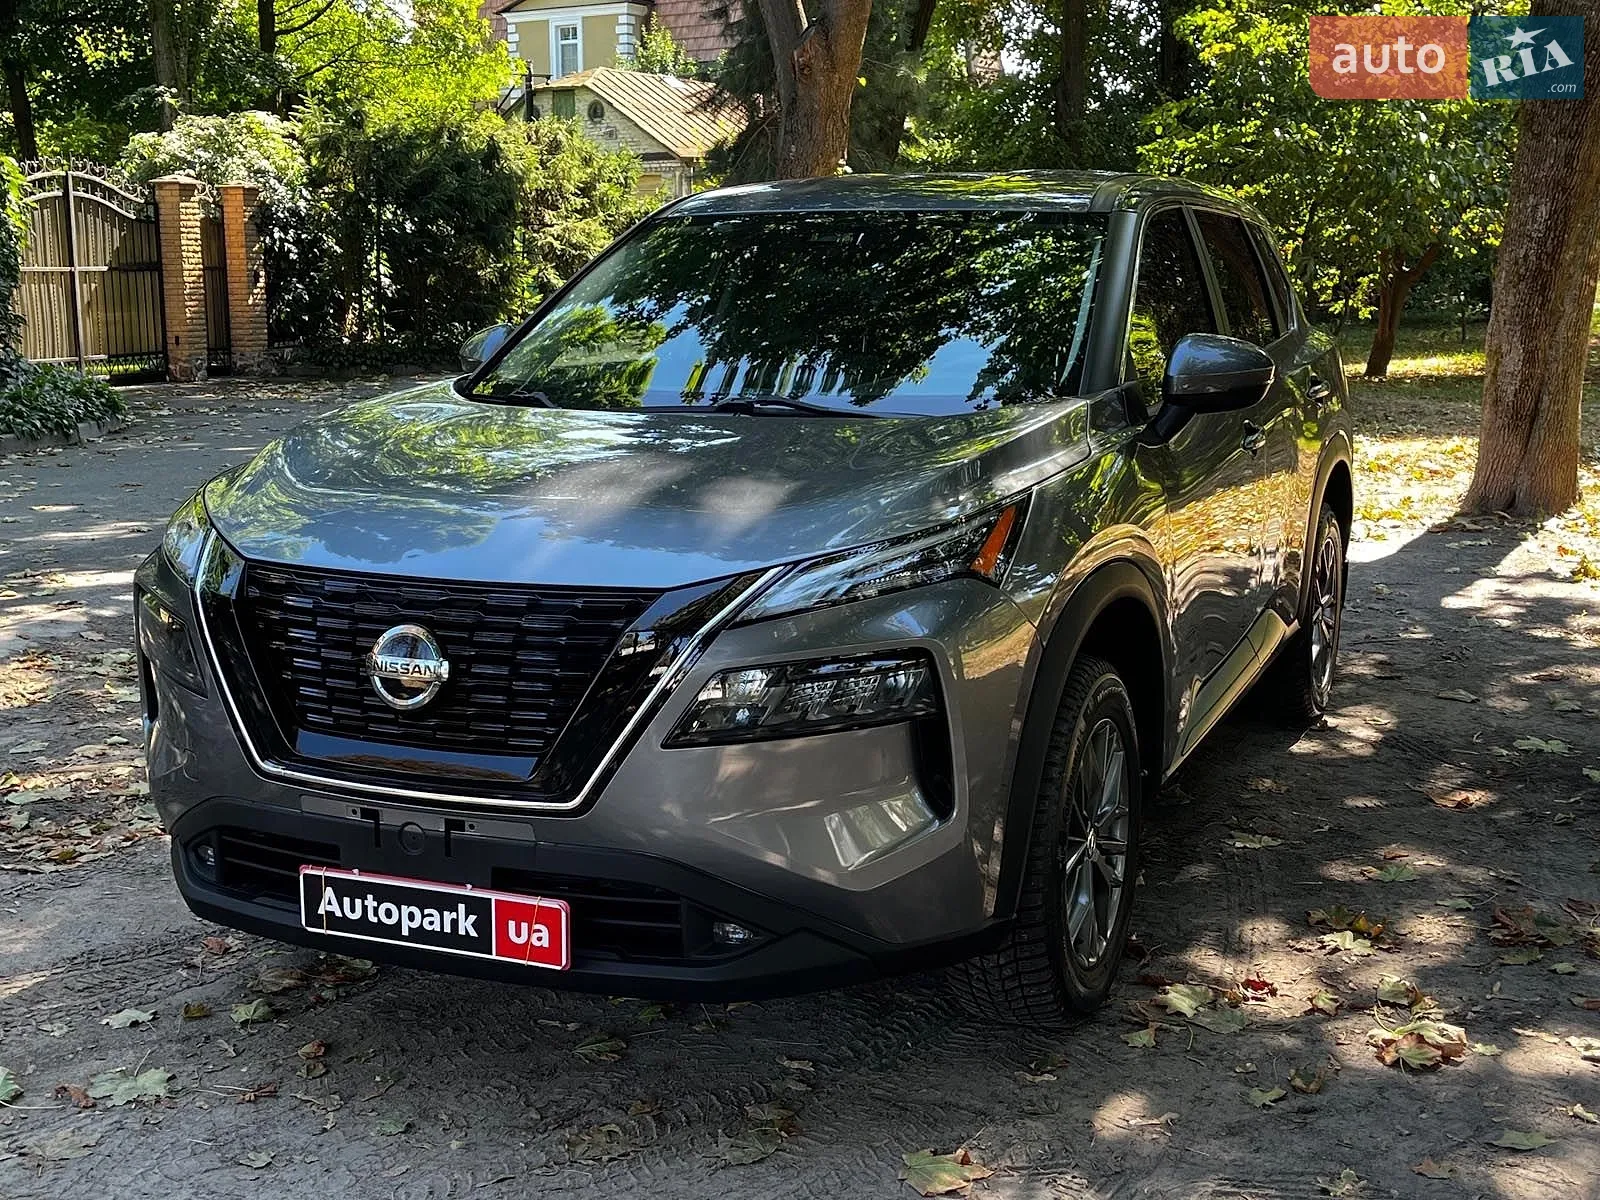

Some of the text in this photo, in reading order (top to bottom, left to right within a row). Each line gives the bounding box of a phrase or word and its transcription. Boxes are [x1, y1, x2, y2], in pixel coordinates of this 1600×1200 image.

[373, 660, 436, 676] NISSAN
[317, 886, 550, 948] Autopark ua
